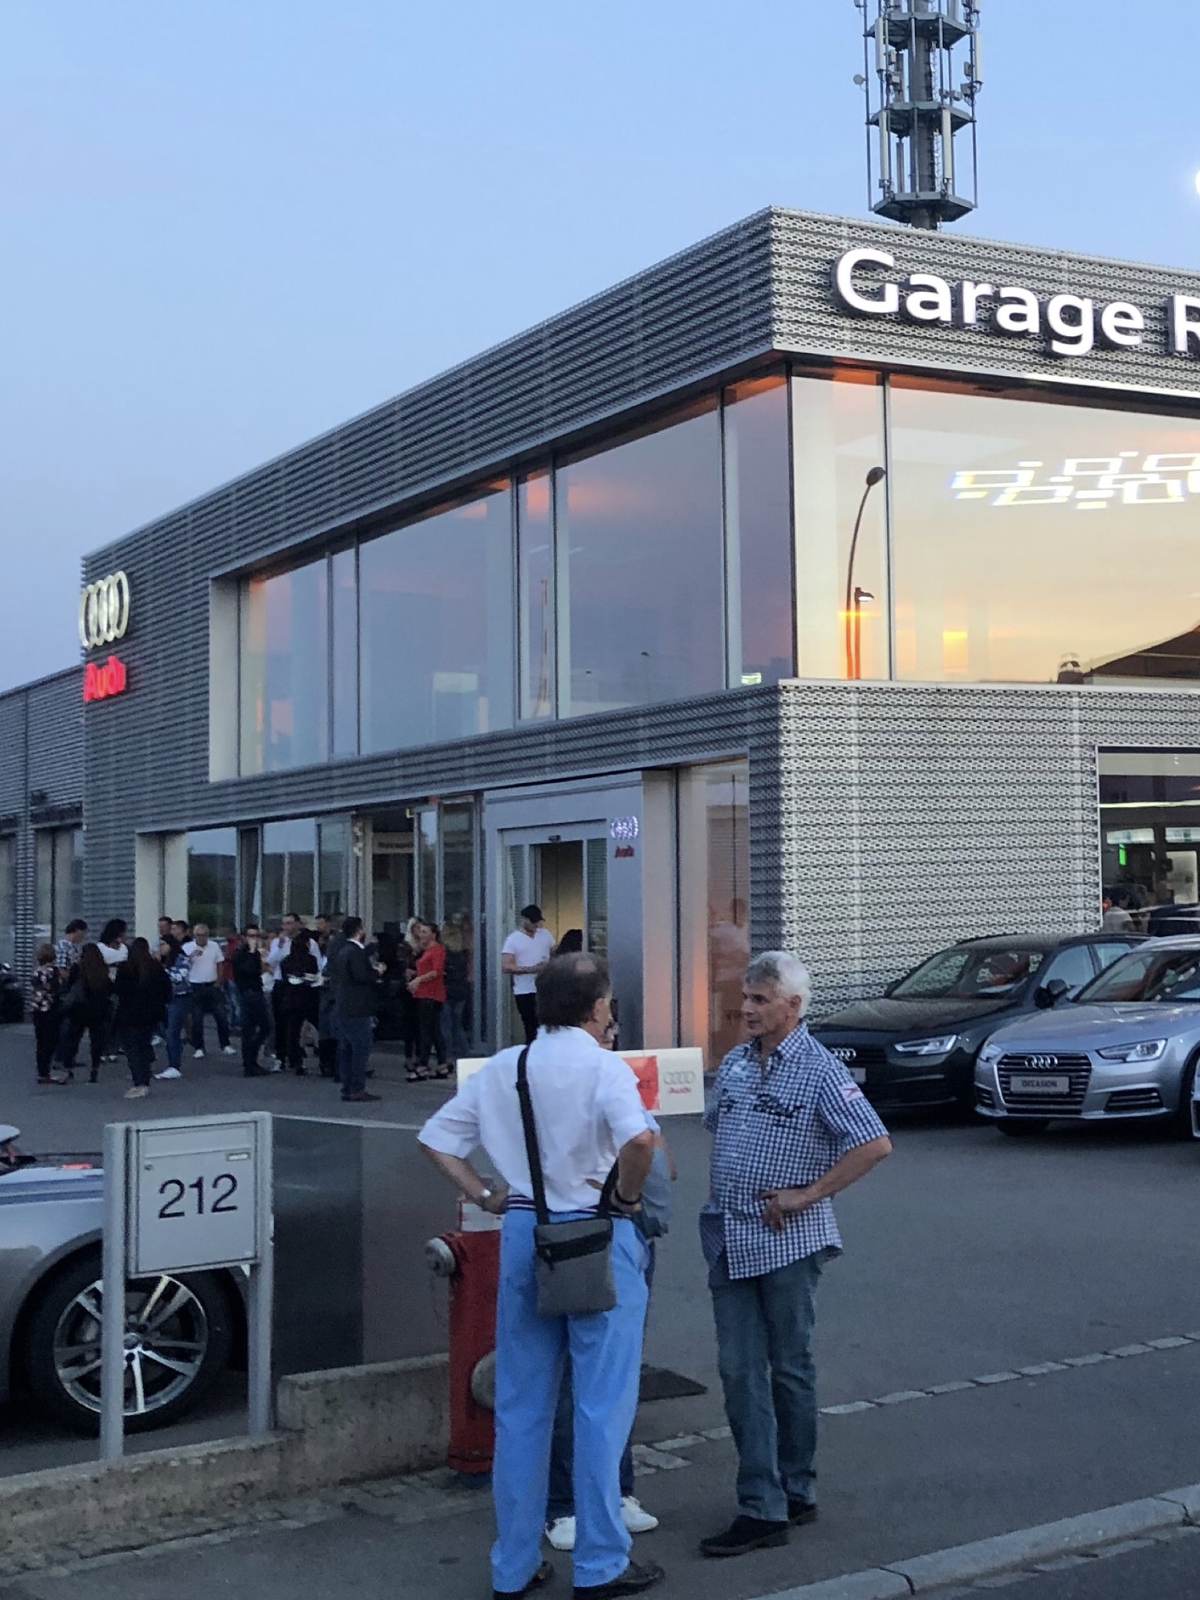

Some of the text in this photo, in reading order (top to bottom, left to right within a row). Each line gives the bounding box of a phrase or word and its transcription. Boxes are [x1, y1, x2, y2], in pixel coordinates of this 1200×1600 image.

[834, 248, 1145, 356] Garage
[83, 655, 126, 702] Audi
[1021, 1080, 1058, 1088] OCCASION
[158, 1173, 238, 1219] 212
